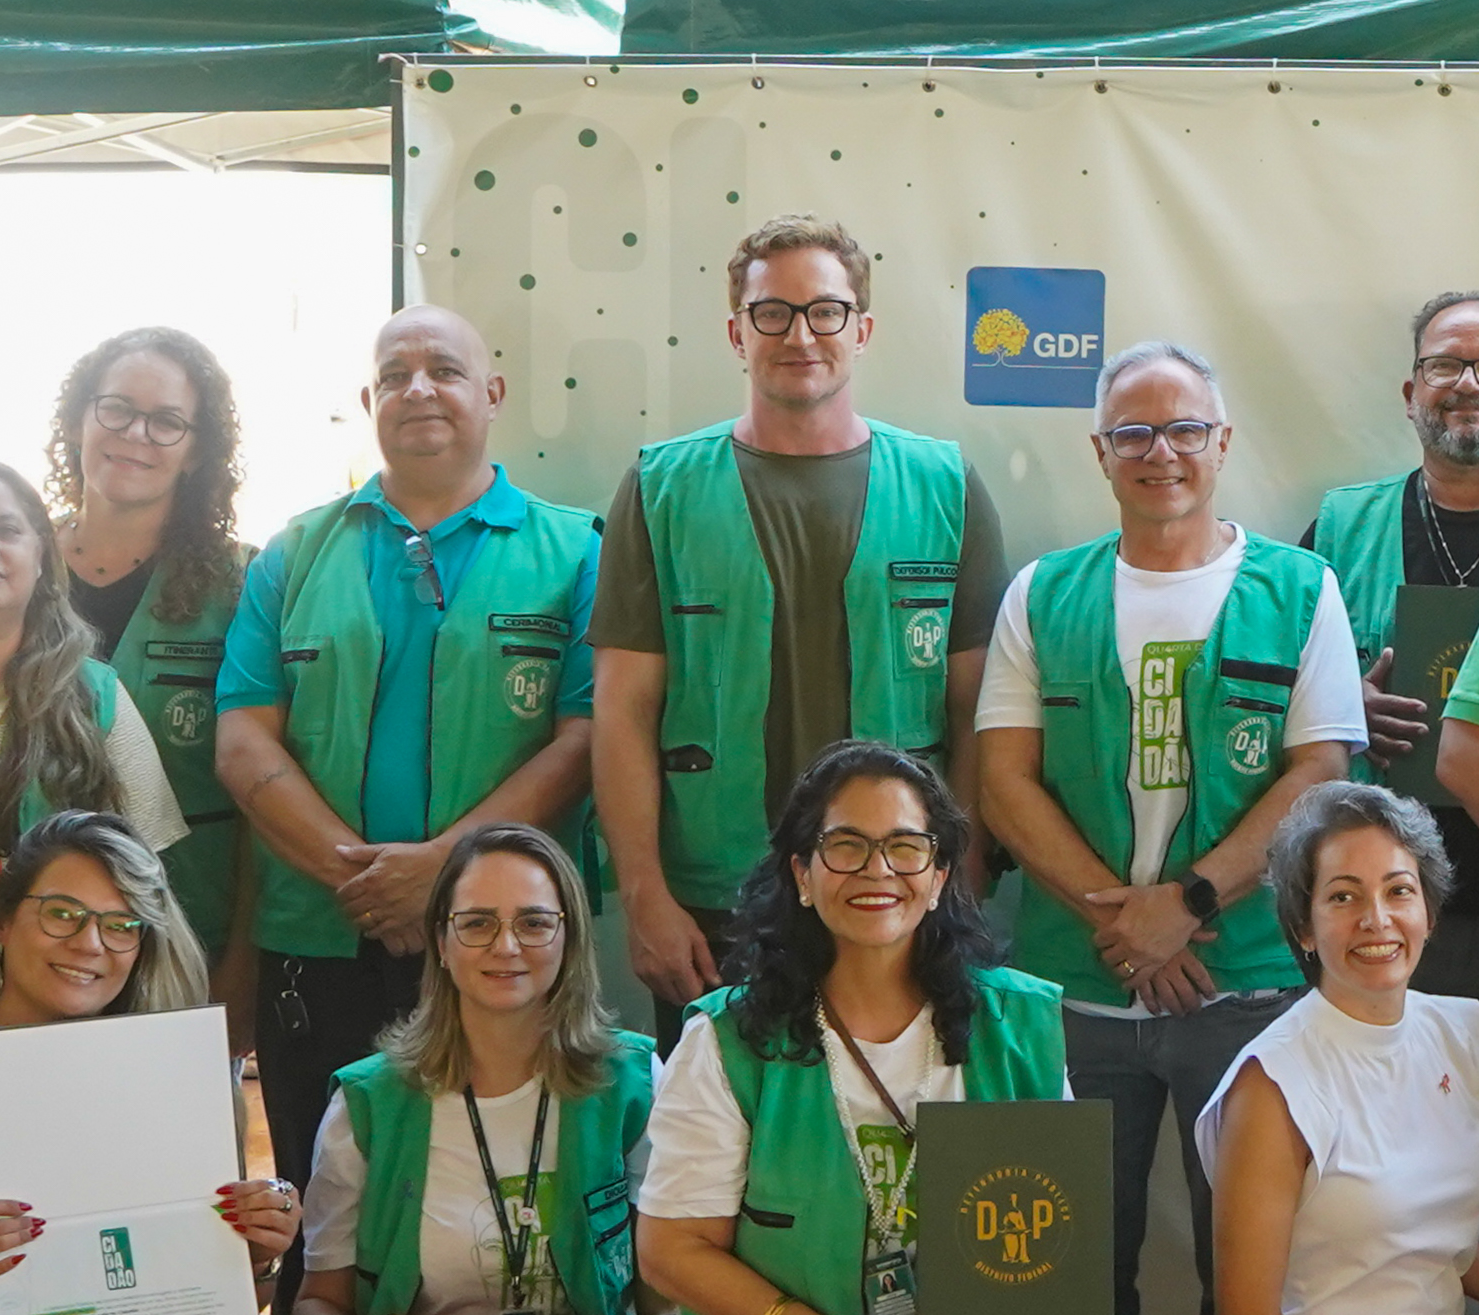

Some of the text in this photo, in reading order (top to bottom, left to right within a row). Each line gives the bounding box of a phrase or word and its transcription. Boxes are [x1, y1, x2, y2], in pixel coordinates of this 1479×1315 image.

[1033, 331, 1099, 360] GDF
[1143, 657, 1175, 697] CI
[102, 1235, 117, 1254] CI
